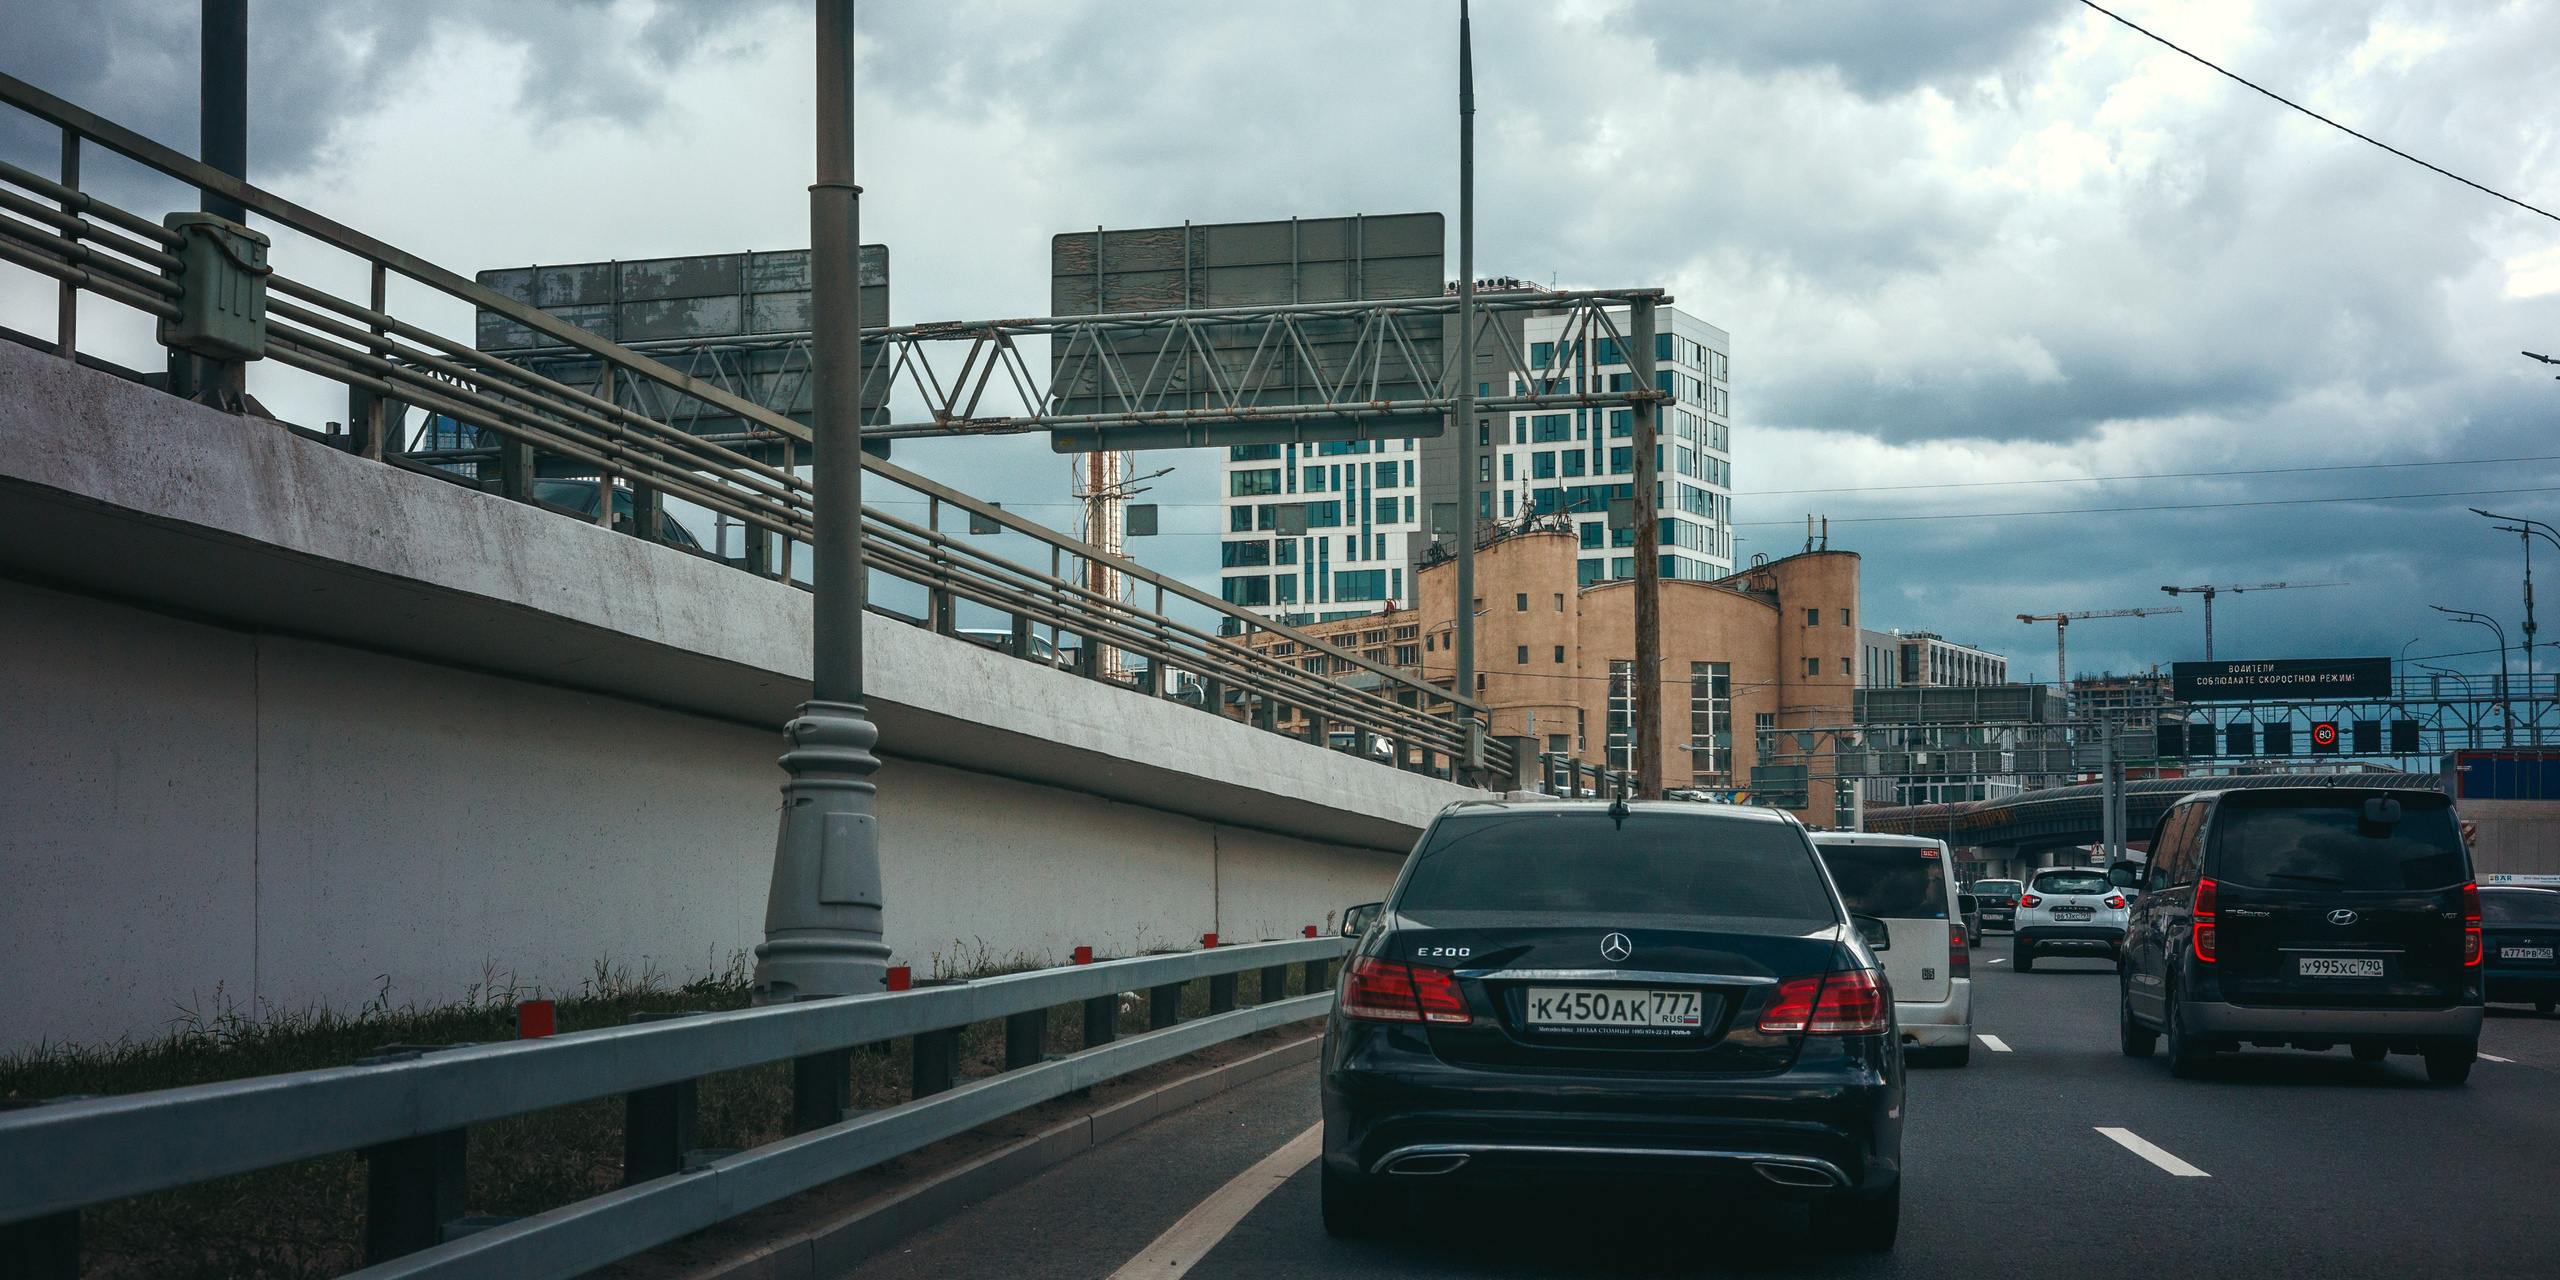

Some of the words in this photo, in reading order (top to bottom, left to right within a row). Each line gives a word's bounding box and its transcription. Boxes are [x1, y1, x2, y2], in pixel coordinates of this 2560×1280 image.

[2228, 664, 2275, 673] ВОДИТЕЛИ
[2196, 675, 2255, 686] СОБЛЮДАЙТЕ
[2258, 673, 2316, 684] СКОРОСТНОЙ
[2319, 730, 2332, 739] 80
[2236, 909, 2271, 918] Starex
[1417, 947, 1429, 957] E
[1432, 947, 1470, 957] 200
[2304, 960, 2357, 974] У995ХС
[2359, 960, 2380, 971] 790
[1537, 992, 1646, 1022] К450АК
[1652, 992, 1695, 1015] 777
[1662, 1015, 1683, 1023] RUS
[1598, 1027, 1630, 1035] СТОЛИЦЫ
